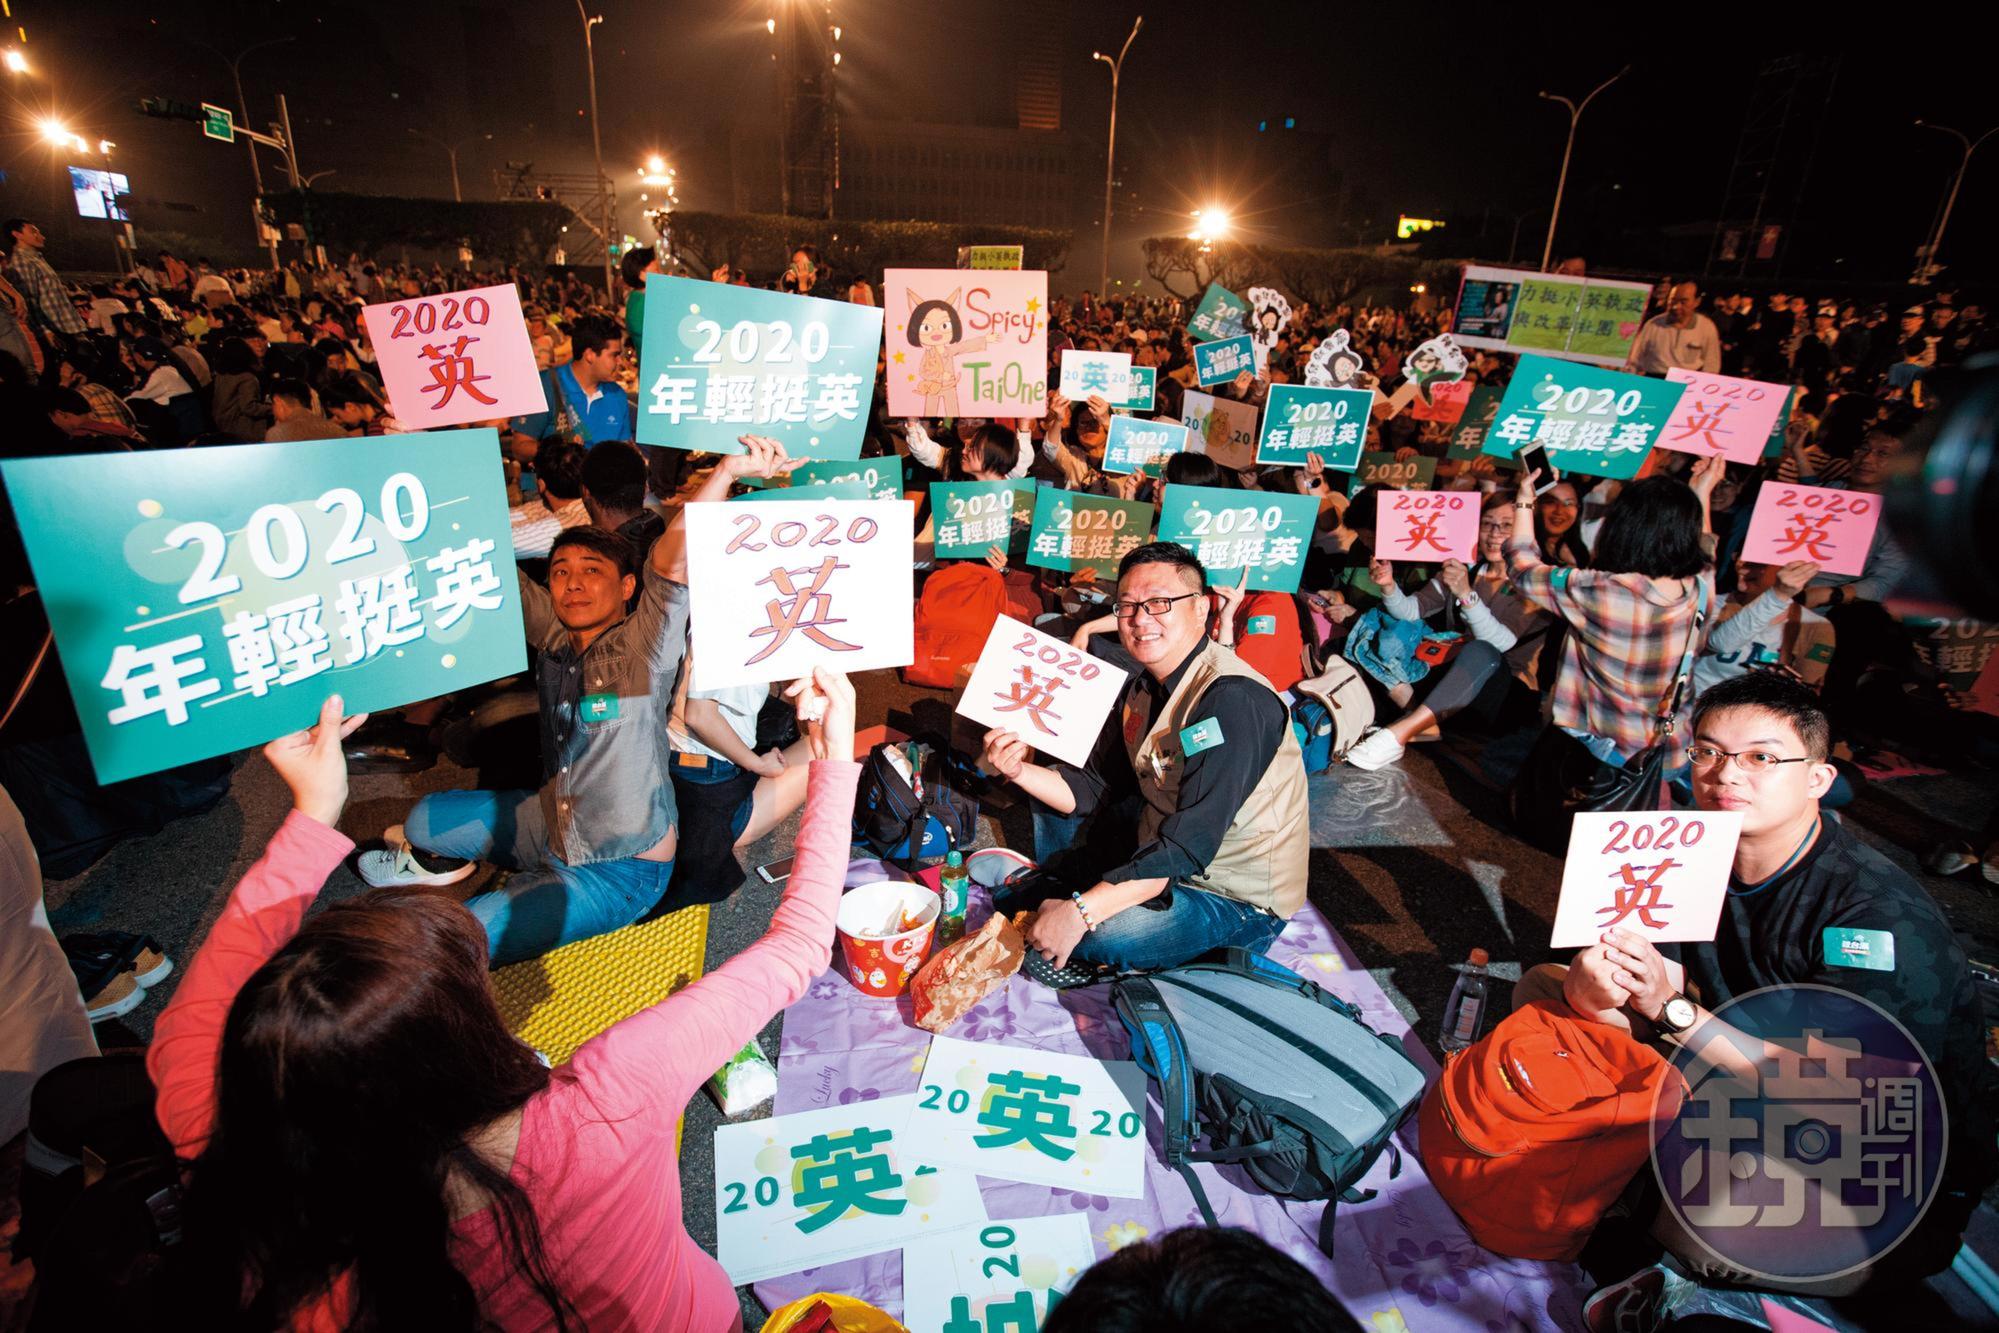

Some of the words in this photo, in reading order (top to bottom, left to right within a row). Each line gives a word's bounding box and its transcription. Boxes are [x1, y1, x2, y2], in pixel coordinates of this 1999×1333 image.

[390, 296, 490, 340] 2020
[965, 287, 1036, 344] Spicy
[1519, 284, 1645, 313] 力挺小英執政
[693, 320, 831, 364] 2020
[1208, 343, 1240, 364] 2020
[417, 335, 499, 410] 英
[1081, 361, 1109, 393] 英
[1202, 352, 1252, 379] 年輕挺英
[648, 372, 863, 425] 年輕挺英
[1536, 384, 1643, 417] 2020
[1683, 375, 1767, 402] 2020
[1184, 416, 1200, 431] 20
[1233, 430, 1250, 446] 20
[1287, 400, 1349, 424] 2020
[1669, 400, 1741, 451] 英
[1124, 431, 1169, 446] 2020
[1265, 422, 1361, 452] 年輕挺英
[1495, 413, 1656, 454] 年輕挺英
[1365, 463, 1418, 480] 2020
[953, 489, 1015, 520] 2020
[1057, 509, 1128, 530] 2020
[1191, 506, 1283, 536] 2020
[1392, 494, 1465, 511] 2020
[1776, 489, 1871, 515] 2020
[164, 471, 432, 605] 2020
[725, 513, 879, 555] 2020
[938, 508, 1031, 548] 年輕挺英
[1394, 511, 1454, 553] 英
[1772, 512, 1843, 562] 英
[1181, 536, 1303, 570] 輕挺英
[743, 555, 864, 667] 英
[100, 537, 505, 727] 年輕挺英
[1012, 632, 1101, 681] 2020
[993, 664, 1071, 737] 英
[1601, 816, 1706, 855] 2020
[1595, 857, 1684, 930] 英
[918, 1084, 971, 1114] 20
[972, 1069, 1082, 1162] 英
[1089, 1109, 1141, 1139] 20
[723, 1175, 780, 1214] 20
[790, 1126, 908, 1235] 英
[979, 1225, 1021, 1280] 20
